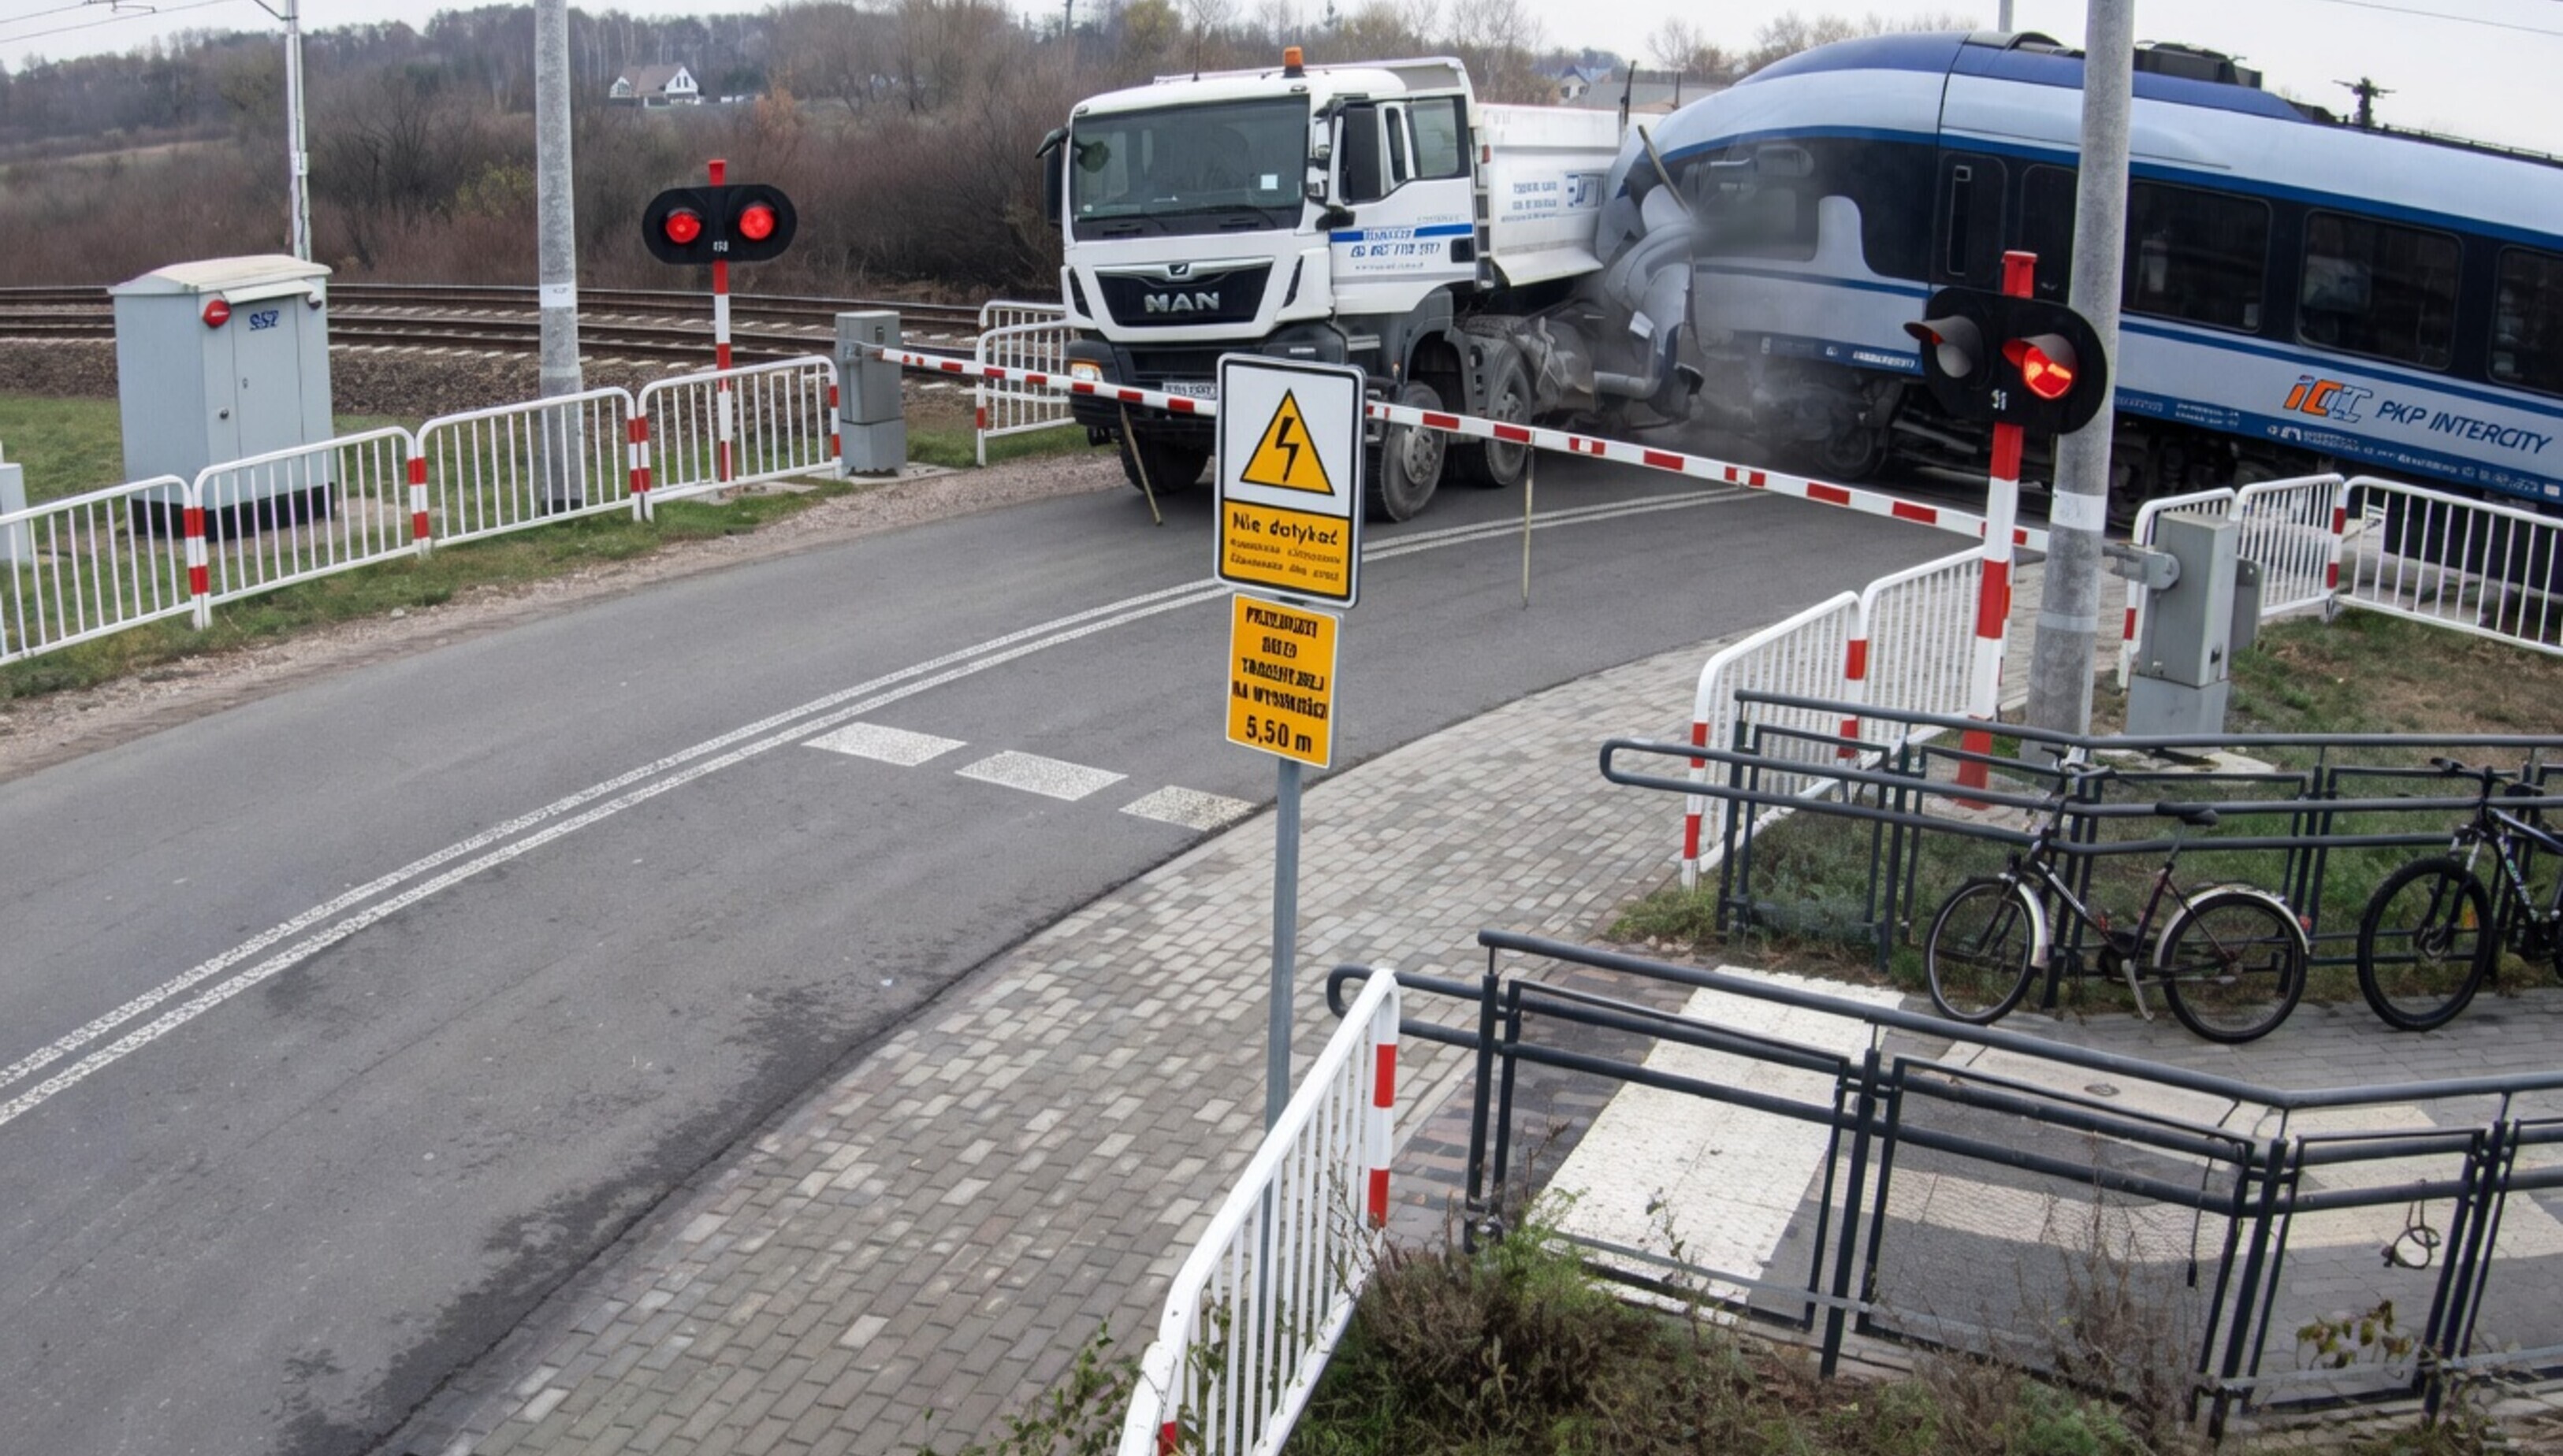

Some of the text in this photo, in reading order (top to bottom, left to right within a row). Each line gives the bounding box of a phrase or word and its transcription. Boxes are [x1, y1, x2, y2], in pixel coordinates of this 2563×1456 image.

[1144, 291, 1219, 313] MAN
[2375, 400, 2554, 455] PKP INTERCITY
[1233, 512, 1261, 533] Nie
[1245, 714, 1312, 753] 5,50 m
